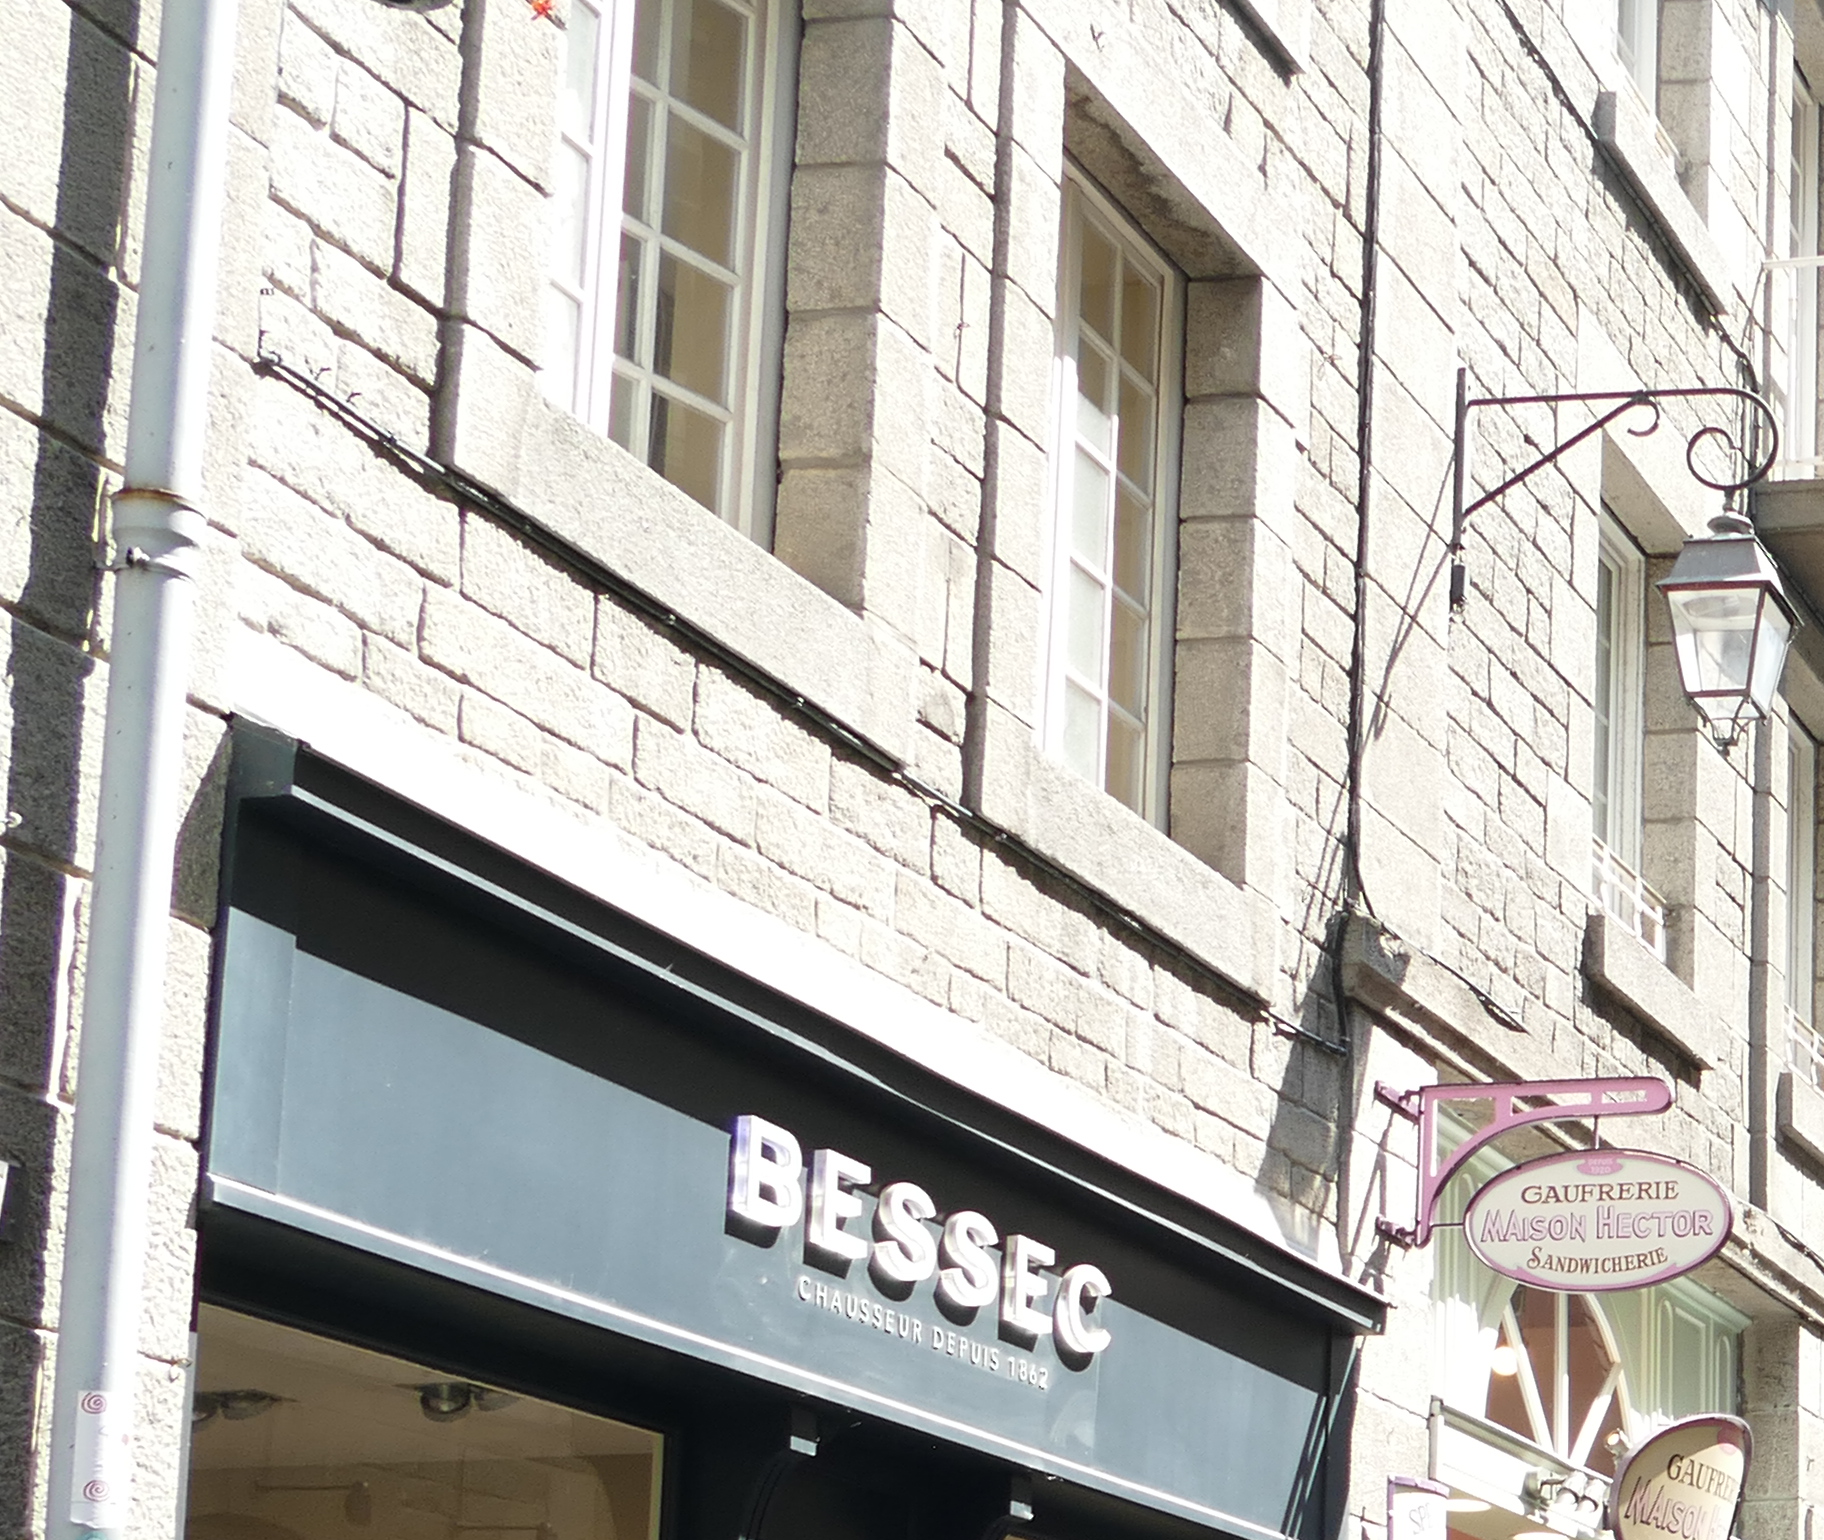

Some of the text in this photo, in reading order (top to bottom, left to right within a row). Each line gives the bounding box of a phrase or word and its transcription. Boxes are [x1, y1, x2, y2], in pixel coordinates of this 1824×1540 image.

[1521, 1180, 1680, 1204] GAUFRERIE
[732, 1114, 1112, 1354] BESSEC
[1480, 1205, 1714, 1243] MAISON HECTOR
[1527, 1246, 1668, 1275] SANDWICHERIE
[797, 1275, 1050, 1391] CHAUSSEUR DEPUIS 1862
